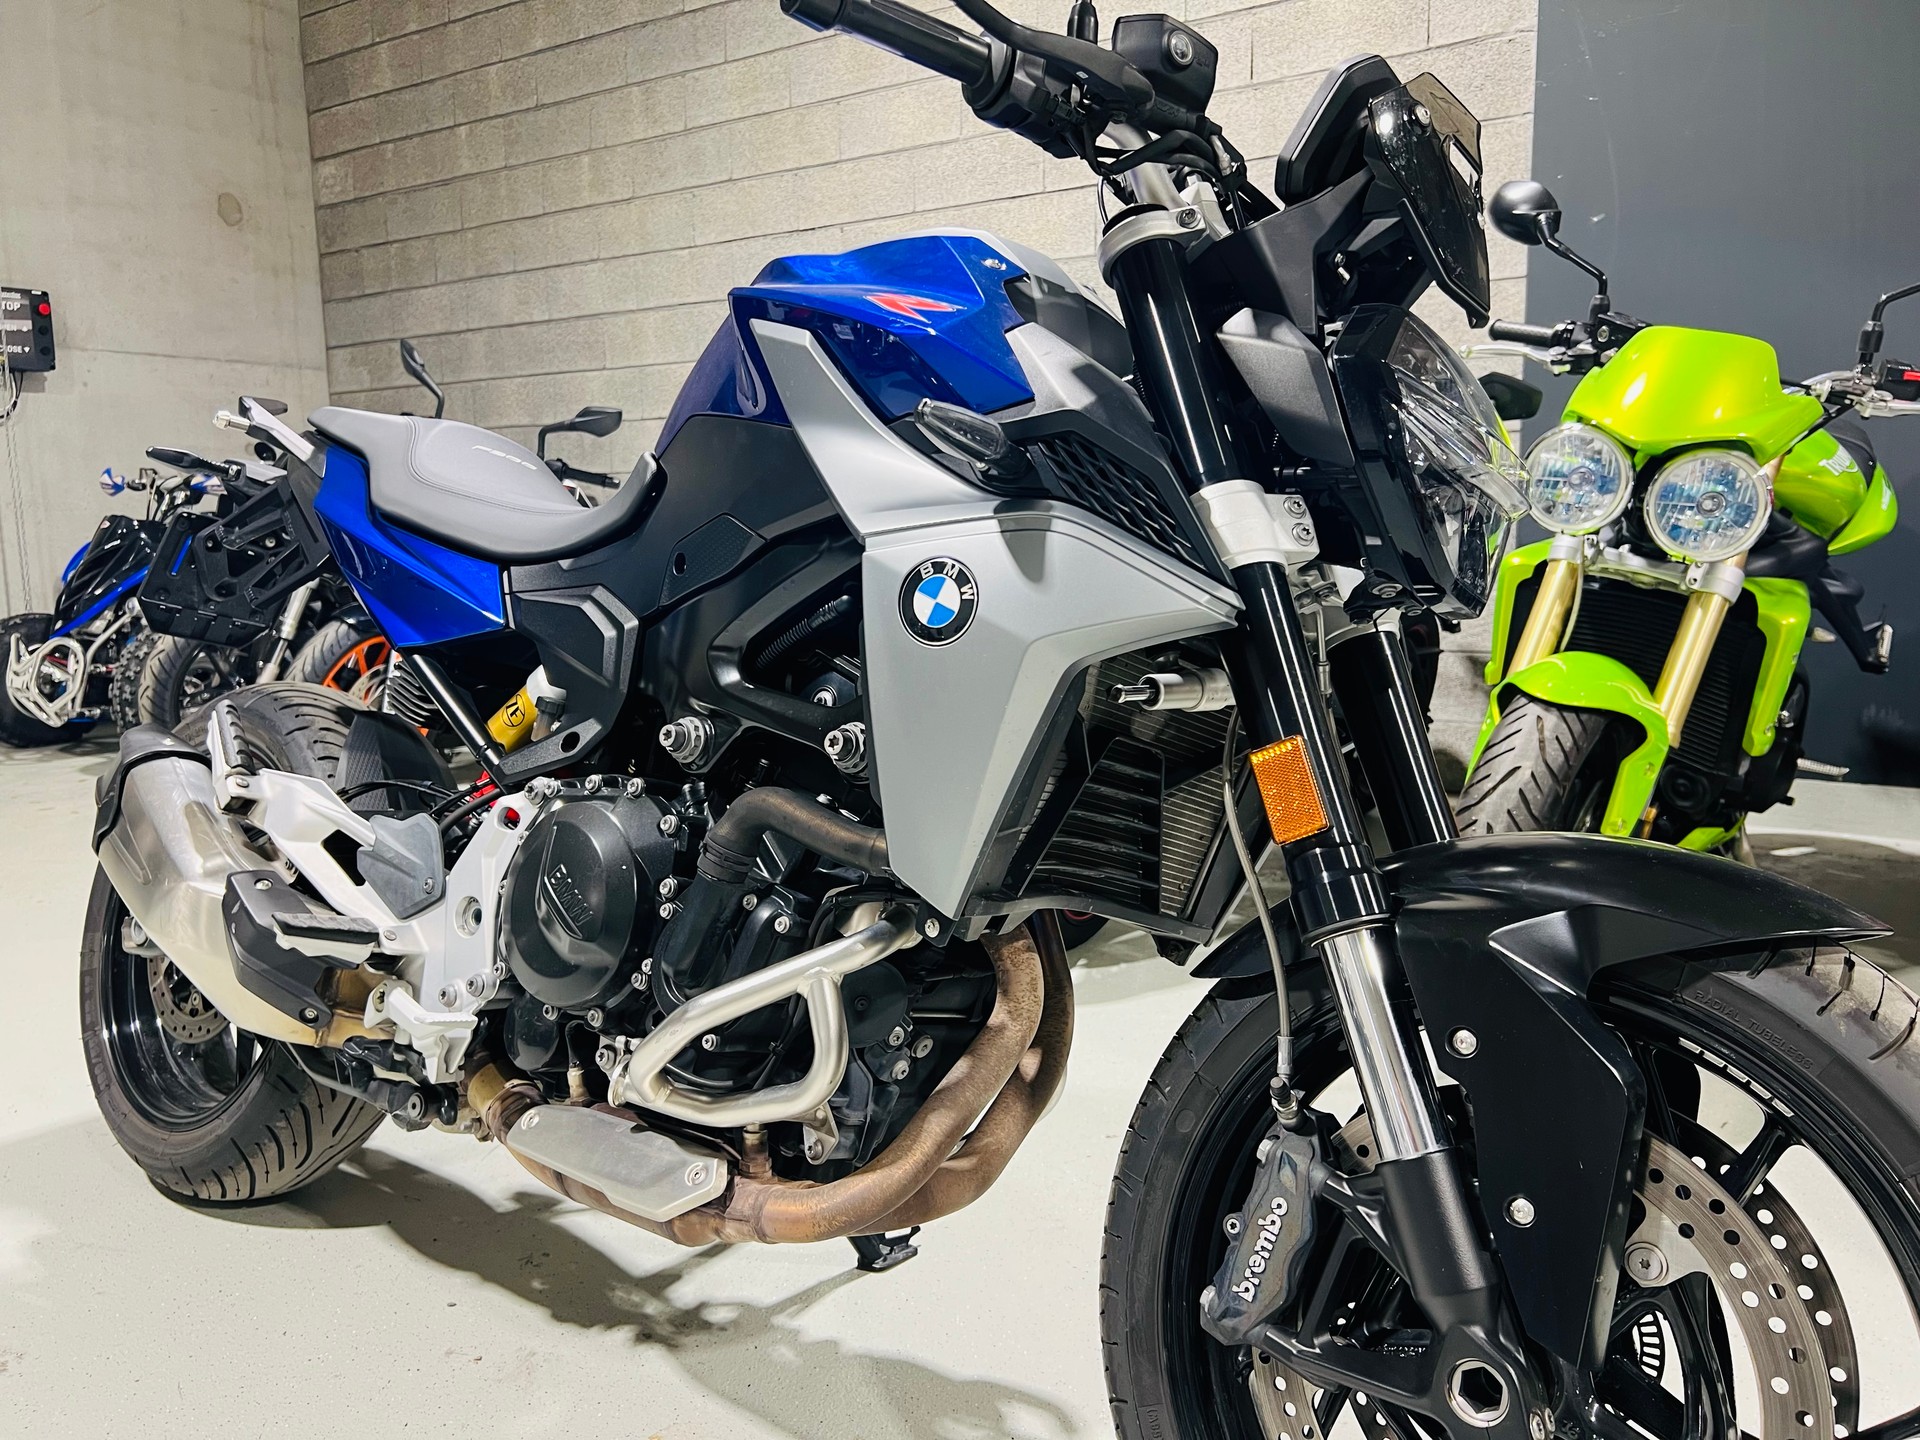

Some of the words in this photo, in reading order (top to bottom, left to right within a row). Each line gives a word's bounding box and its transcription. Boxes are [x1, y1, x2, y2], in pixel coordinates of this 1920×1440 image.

[0, 301, 20, 311] TOP
[919, 560, 974, 600] BMW
[1694, 990, 1741, 1023] RADIAL
[1748, 1018, 1815, 1071] TUBELESS
[1231, 1196, 1289, 1303] brembo
